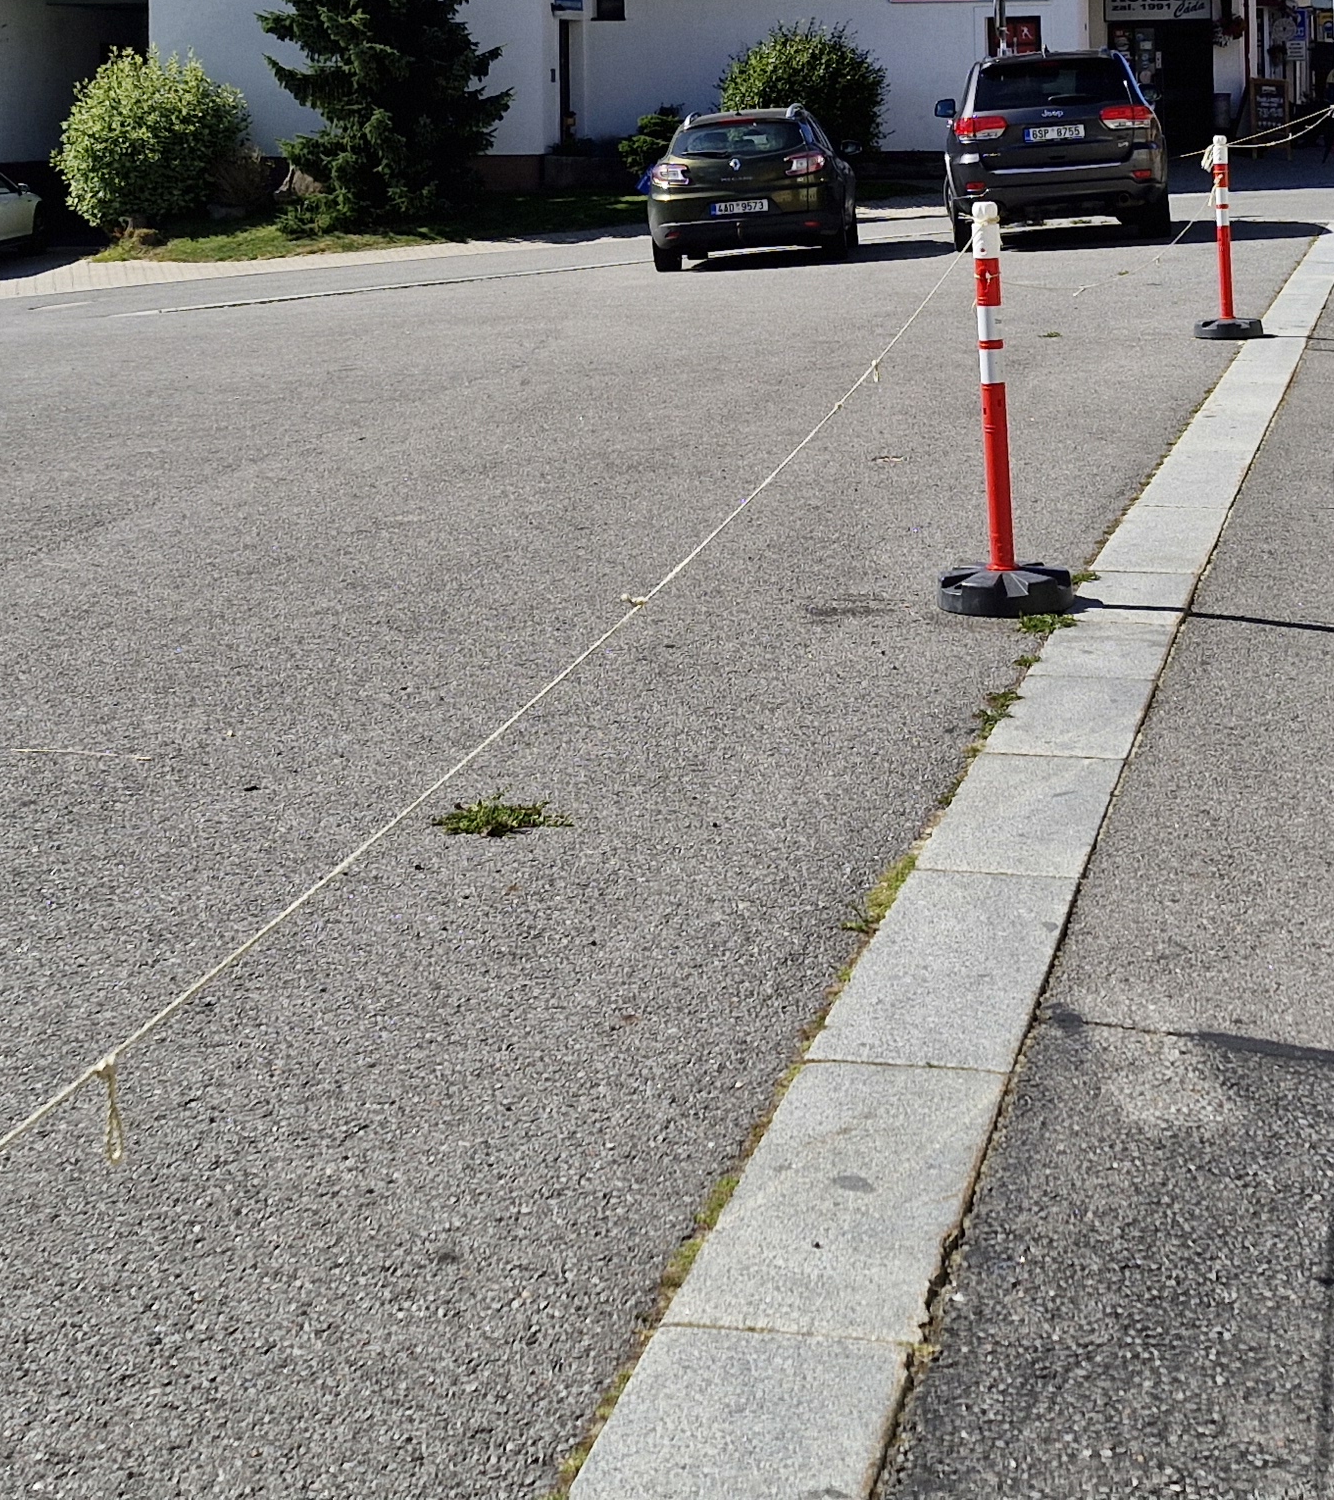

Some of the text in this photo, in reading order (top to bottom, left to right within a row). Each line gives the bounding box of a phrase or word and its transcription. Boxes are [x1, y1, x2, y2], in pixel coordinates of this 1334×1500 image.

[1111, 3, 1171, 11] zal. 1991
[1041, 109, 1064, 118] Jeep
[1032, 126, 1080, 139] 6SP 8755
[742, 201, 764, 211] 9573
